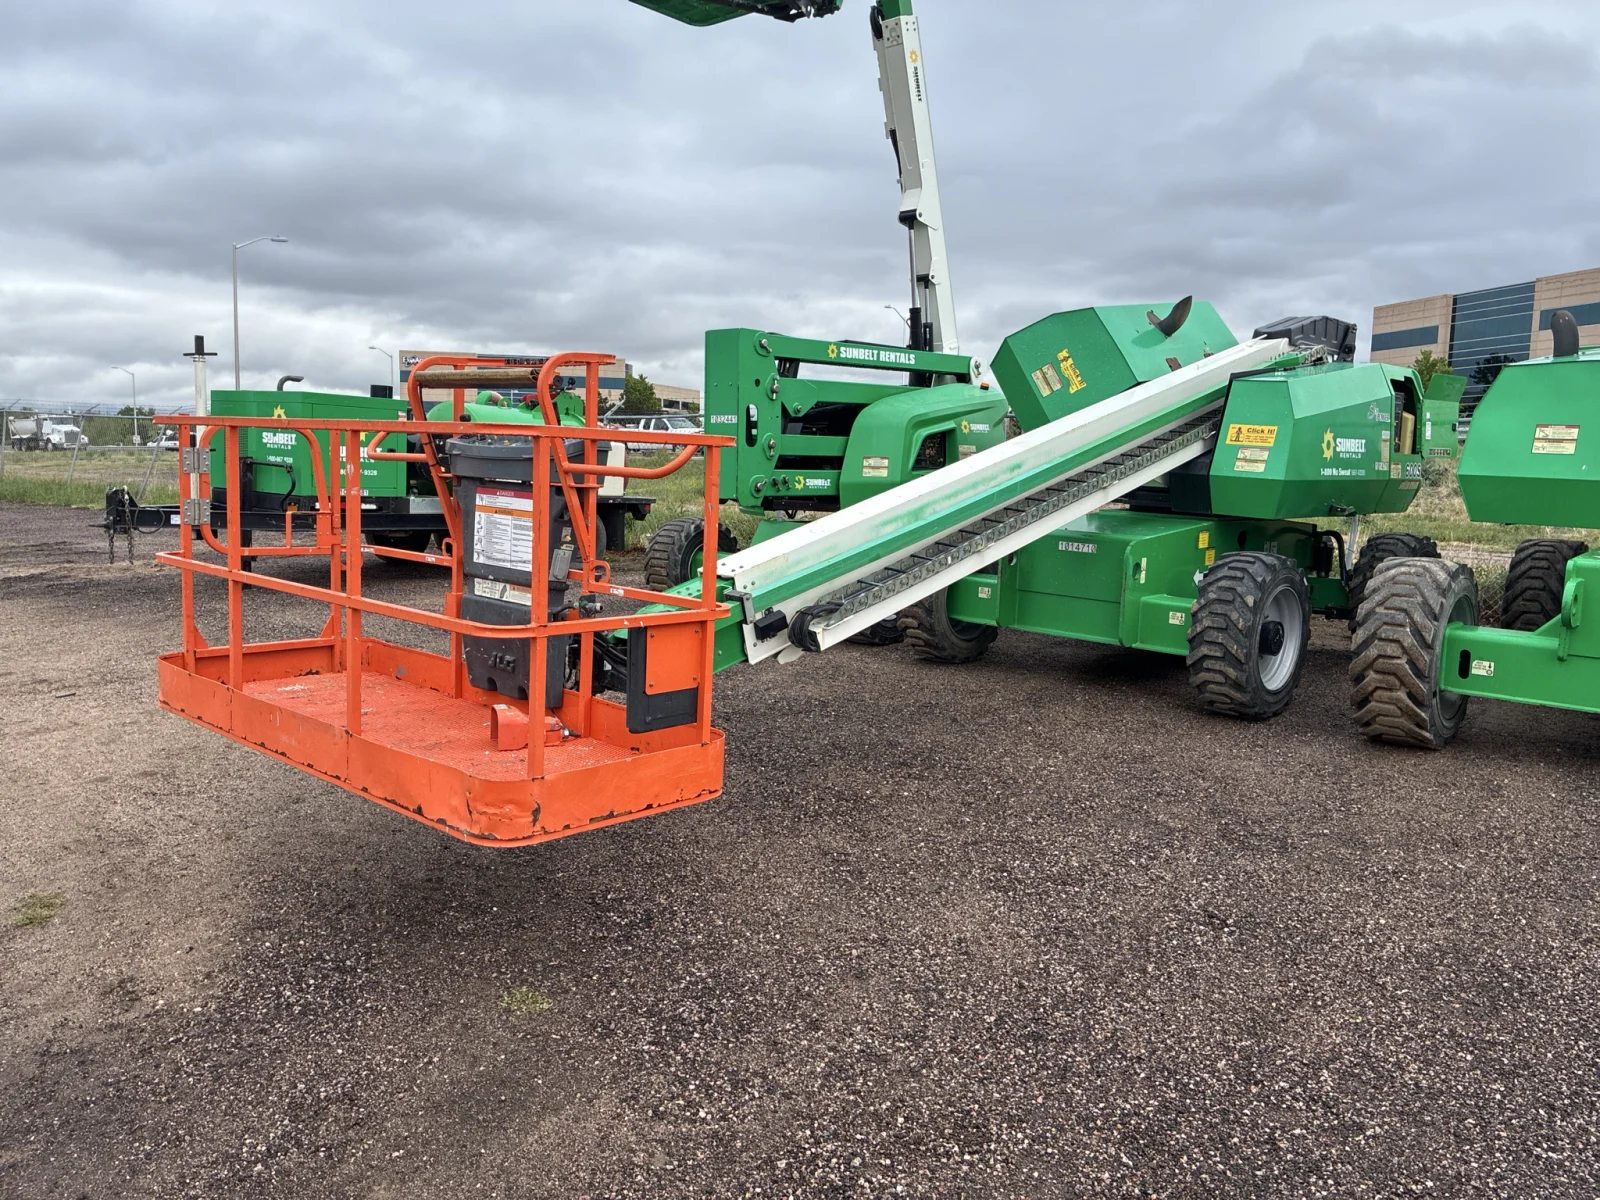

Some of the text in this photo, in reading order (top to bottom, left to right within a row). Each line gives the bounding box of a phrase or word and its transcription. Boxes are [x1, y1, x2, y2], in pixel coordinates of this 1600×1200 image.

[840, 347, 915, 365] SUNBELT RENTALS
[262, 432, 296, 445] SUNBELT
[1336, 438, 1366, 452] SUNBELT
[1320, 467, 1332, 476] 1-800
[1332, 467, 1338, 476] No
[805, 478, 830, 486] SUNBELT
[489, 651, 516, 673] JLG
